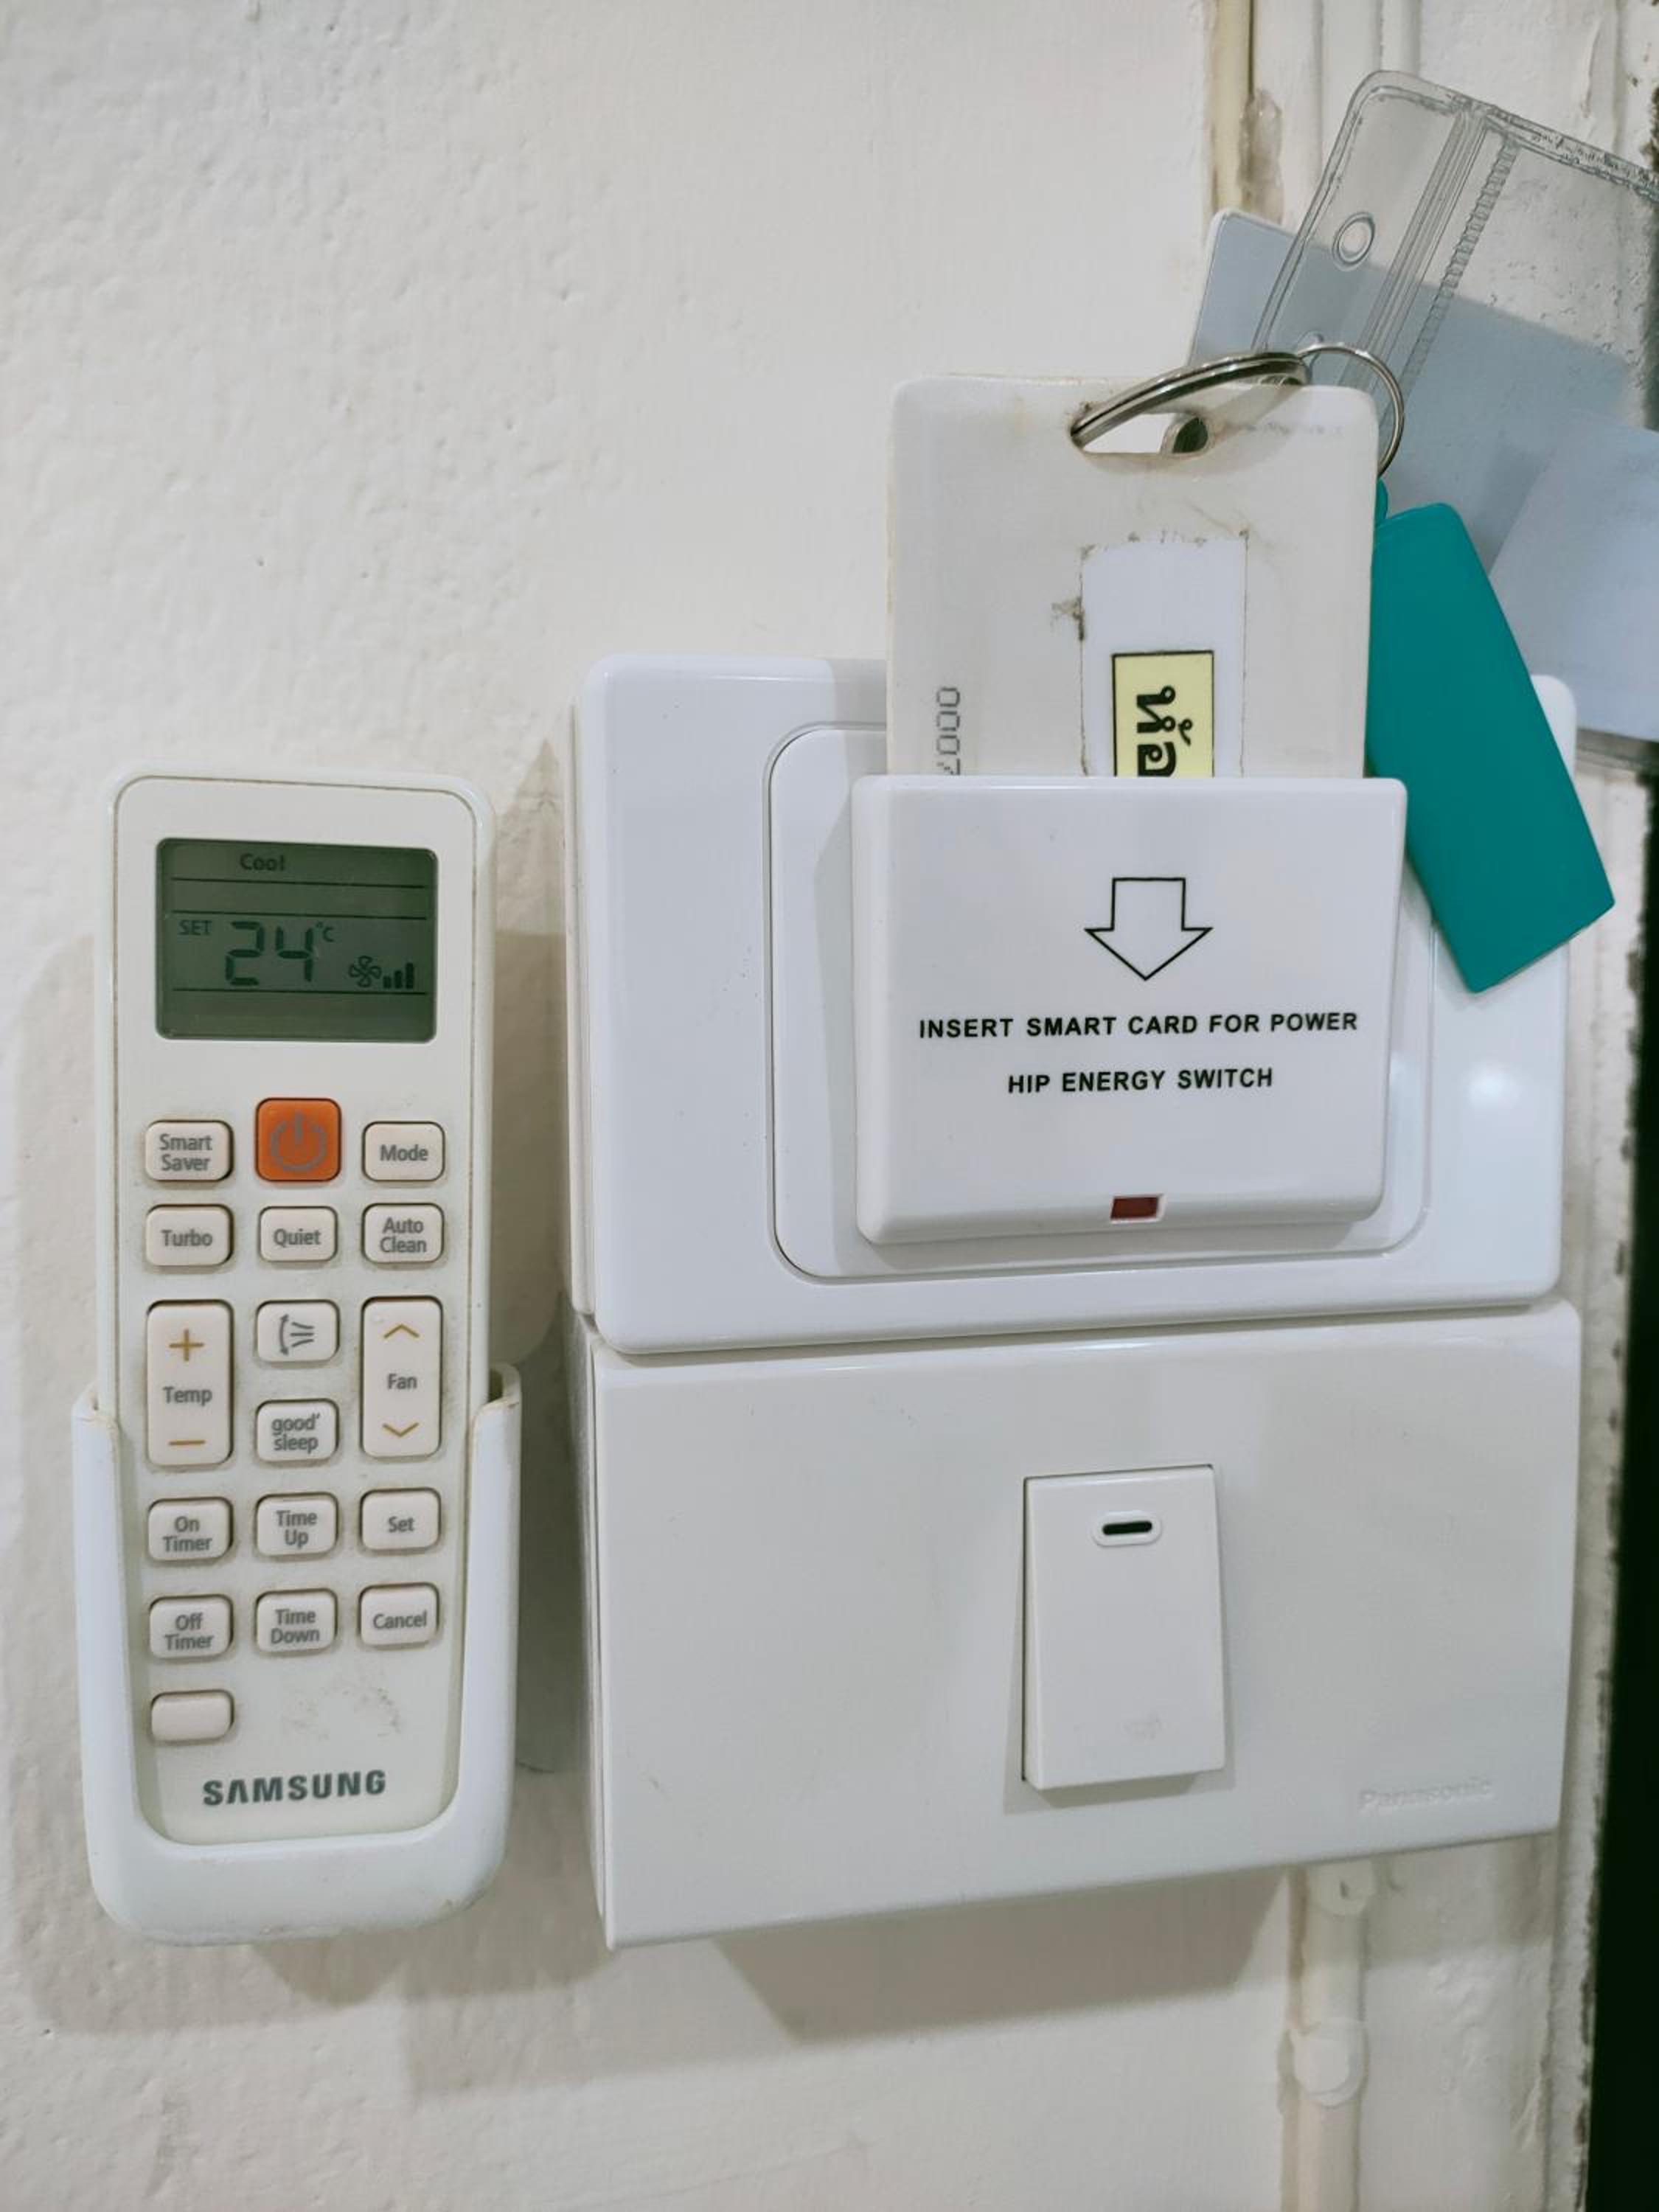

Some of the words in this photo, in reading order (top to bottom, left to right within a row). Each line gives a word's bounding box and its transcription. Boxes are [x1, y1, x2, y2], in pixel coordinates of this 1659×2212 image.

[240, 853, 285, 871] Cool
[179, 919, 212, 936] SET
[920, 1018, 1013, 1038] INSERT
[1027, 1017, 1116, 1036] SMART
[1128, 1015, 1197, 1034] CARD
[1209, 1015, 1259, 1033] FOR
[1271, 1012, 1357, 1032] POWER
[1009, 1075, 1050, 1093] HIP
[1062, 1071, 1165, 1092] ENERGY
[1178, 1068, 1272, 1089] SWITCH
[159, 1133, 212, 1151] Smart
[380, 1144, 428, 1161] Mode
[161, 1154, 210, 1172] Saver
[383, 1217, 424, 1234] Auto
[161, 1228, 212, 1247] Turbo
[274, 1228, 321, 1248] Quiet
[380, 1235, 427, 1253] Clean
[388, 1374, 417, 1390] Fan
[163, 1386, 212, 1406] Temp
[274, 1433, 319, 1454] sleep
[174, 1516, 200, 1533] On
[276, 1510, 318, 1527] Time
[388, 1516, 414, 1533] Set
[163, 1535, 212, 1552] Timer
[285, 1528, 308, 1548] Up
[175, 1613, 203, 1631] Off
[276, 1609, 316, 1625] Time
[373, 1610, 427, 1630] Cancel
[164, 1633, 213, 1650] Timer
[271, 1625, 320, 1644] Down
[203, 1770, 385, 1806] SAMSUNG
